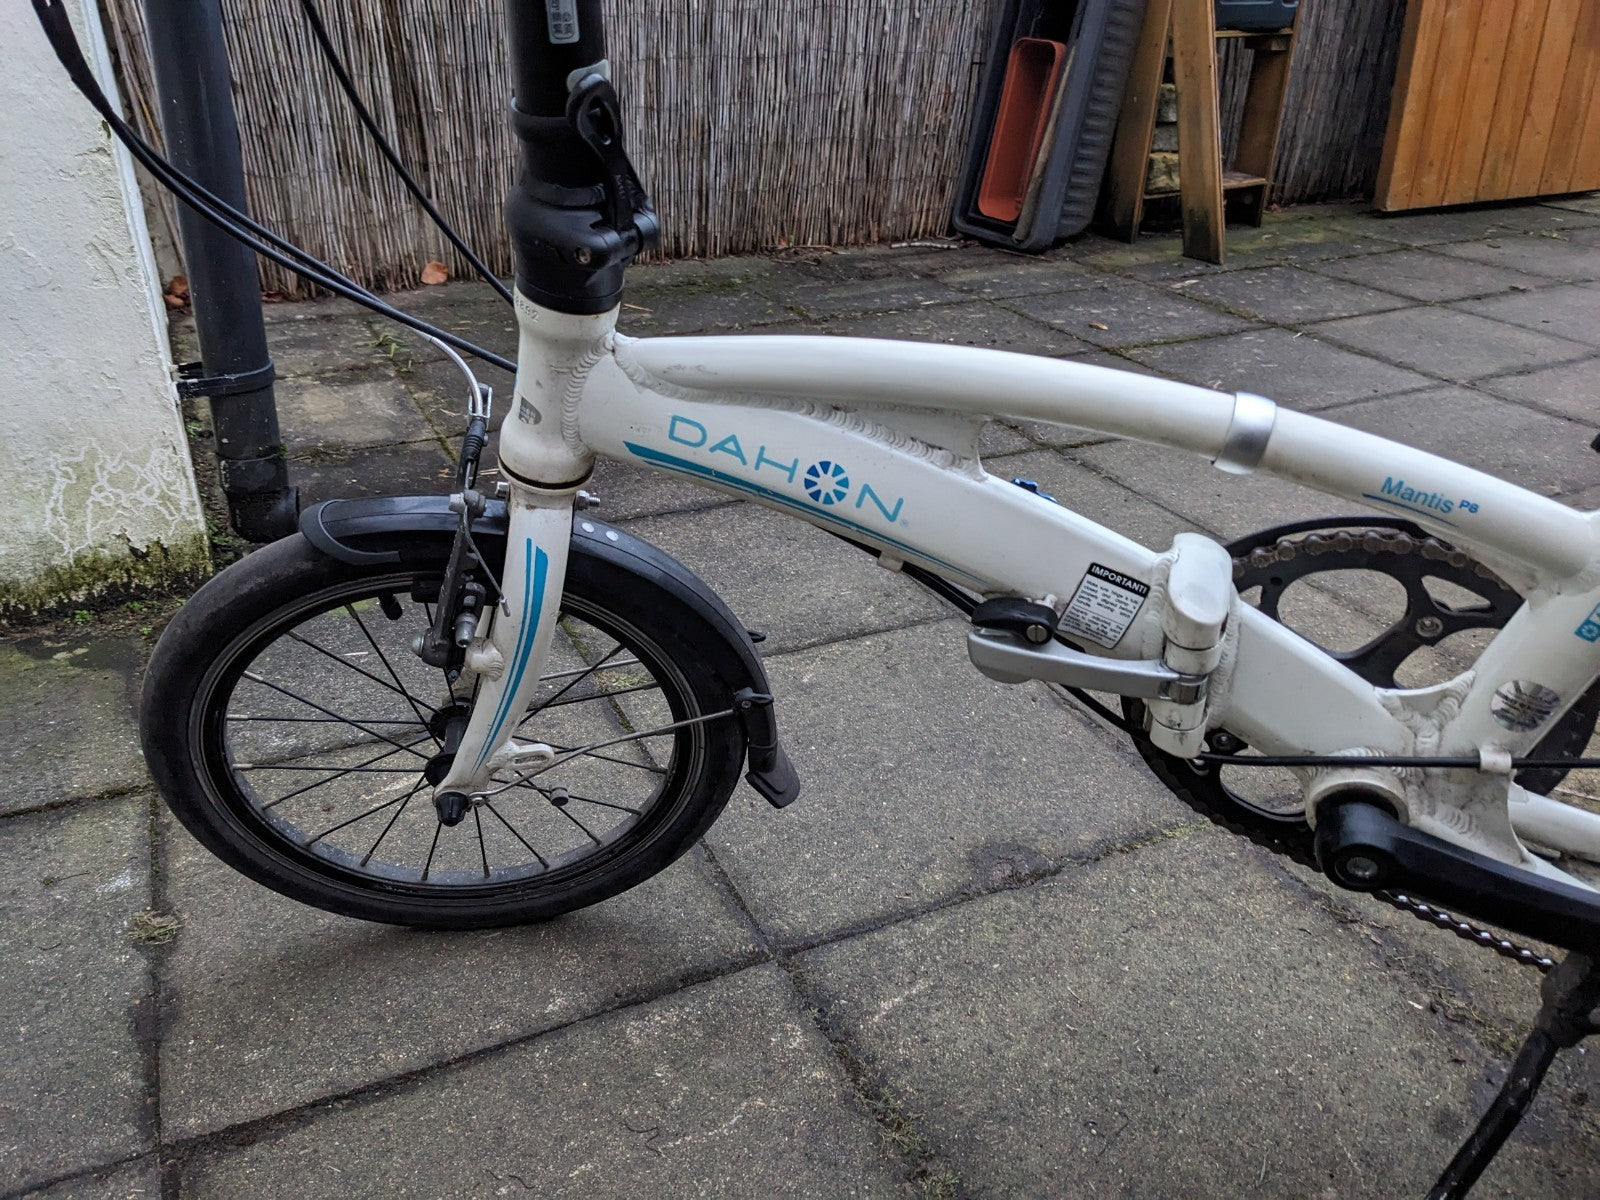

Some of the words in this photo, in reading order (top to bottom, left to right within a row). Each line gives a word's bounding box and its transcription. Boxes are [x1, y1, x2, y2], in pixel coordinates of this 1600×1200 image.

[668, 414, 904, 523] DAHON
[1380, 476, 1455, 514] Mantis
[1459, 499, 1480, 514] P8
